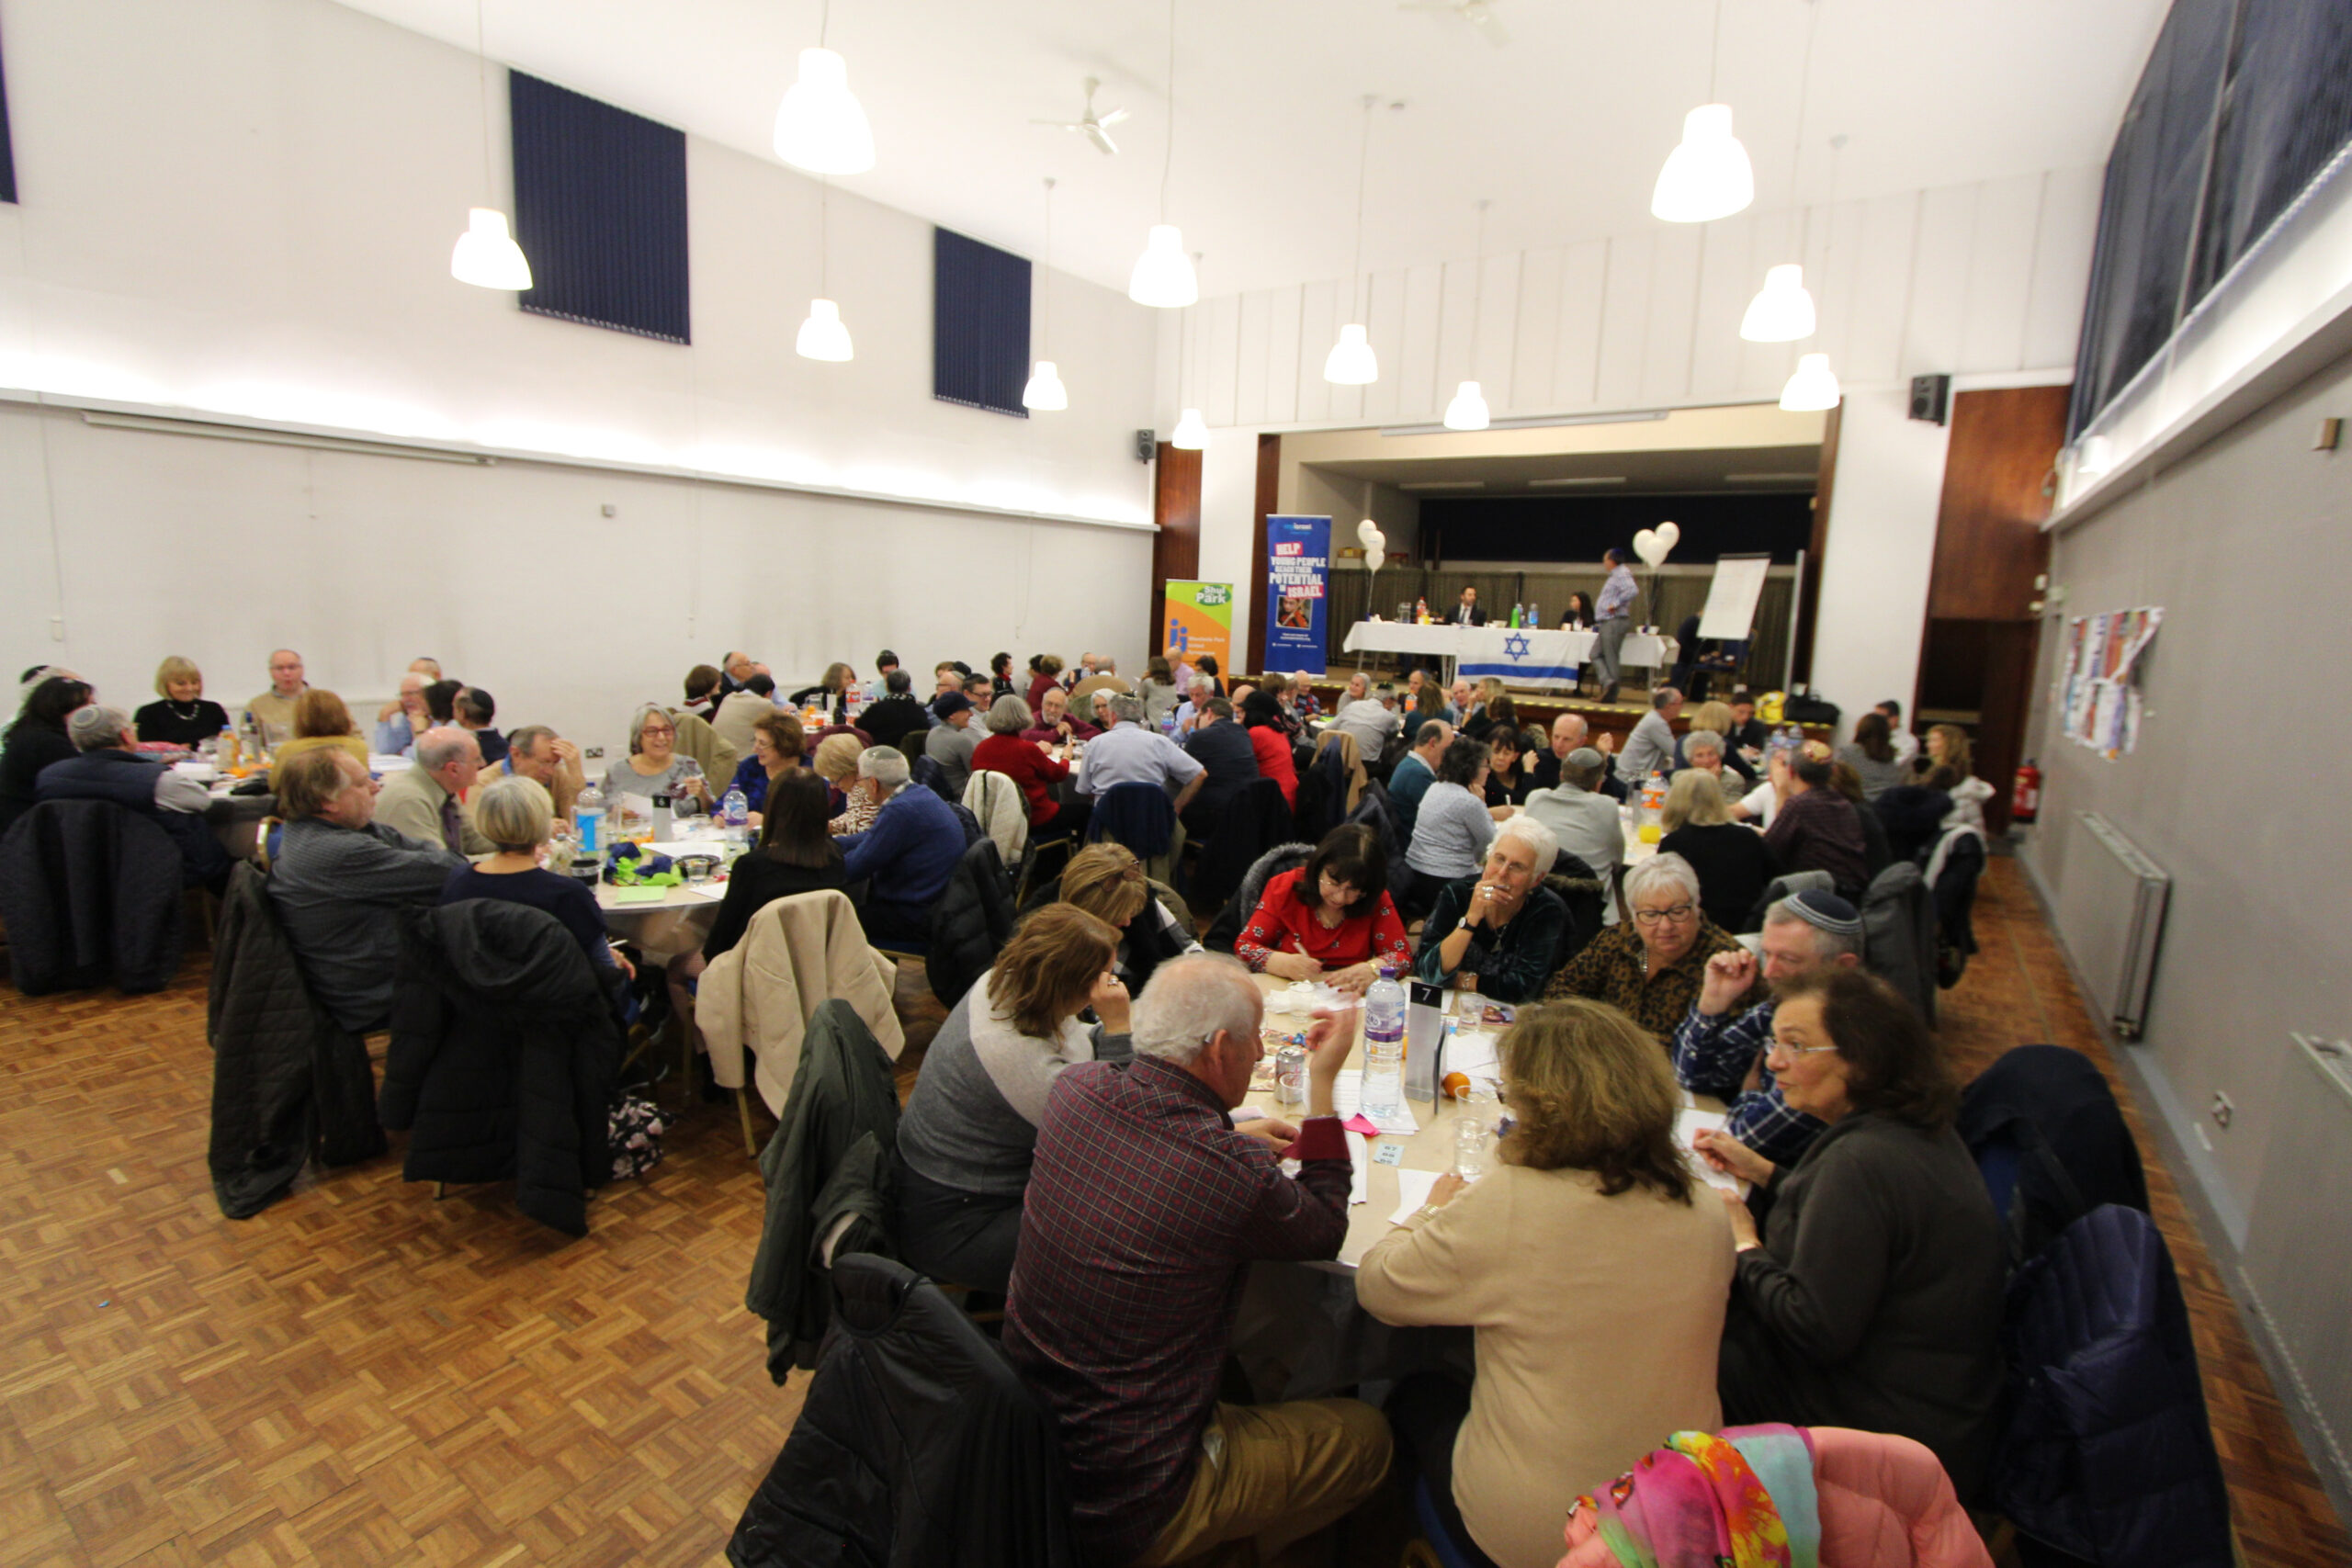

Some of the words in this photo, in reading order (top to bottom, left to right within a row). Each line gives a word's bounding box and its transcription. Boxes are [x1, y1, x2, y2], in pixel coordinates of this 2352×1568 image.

[1275, 542, 1301, 555] HELP
[1296, 557, 1326, 568] PEOPLE
[1269, 572, 1324, 585] POTENTIAL
[1204, 585, 1226, 594] Shul
[1287, 585, 1322, 598] ISRAEL
[1196, 592, 1226, 604] Park
[1421, 987, 1431, 1001] 7
